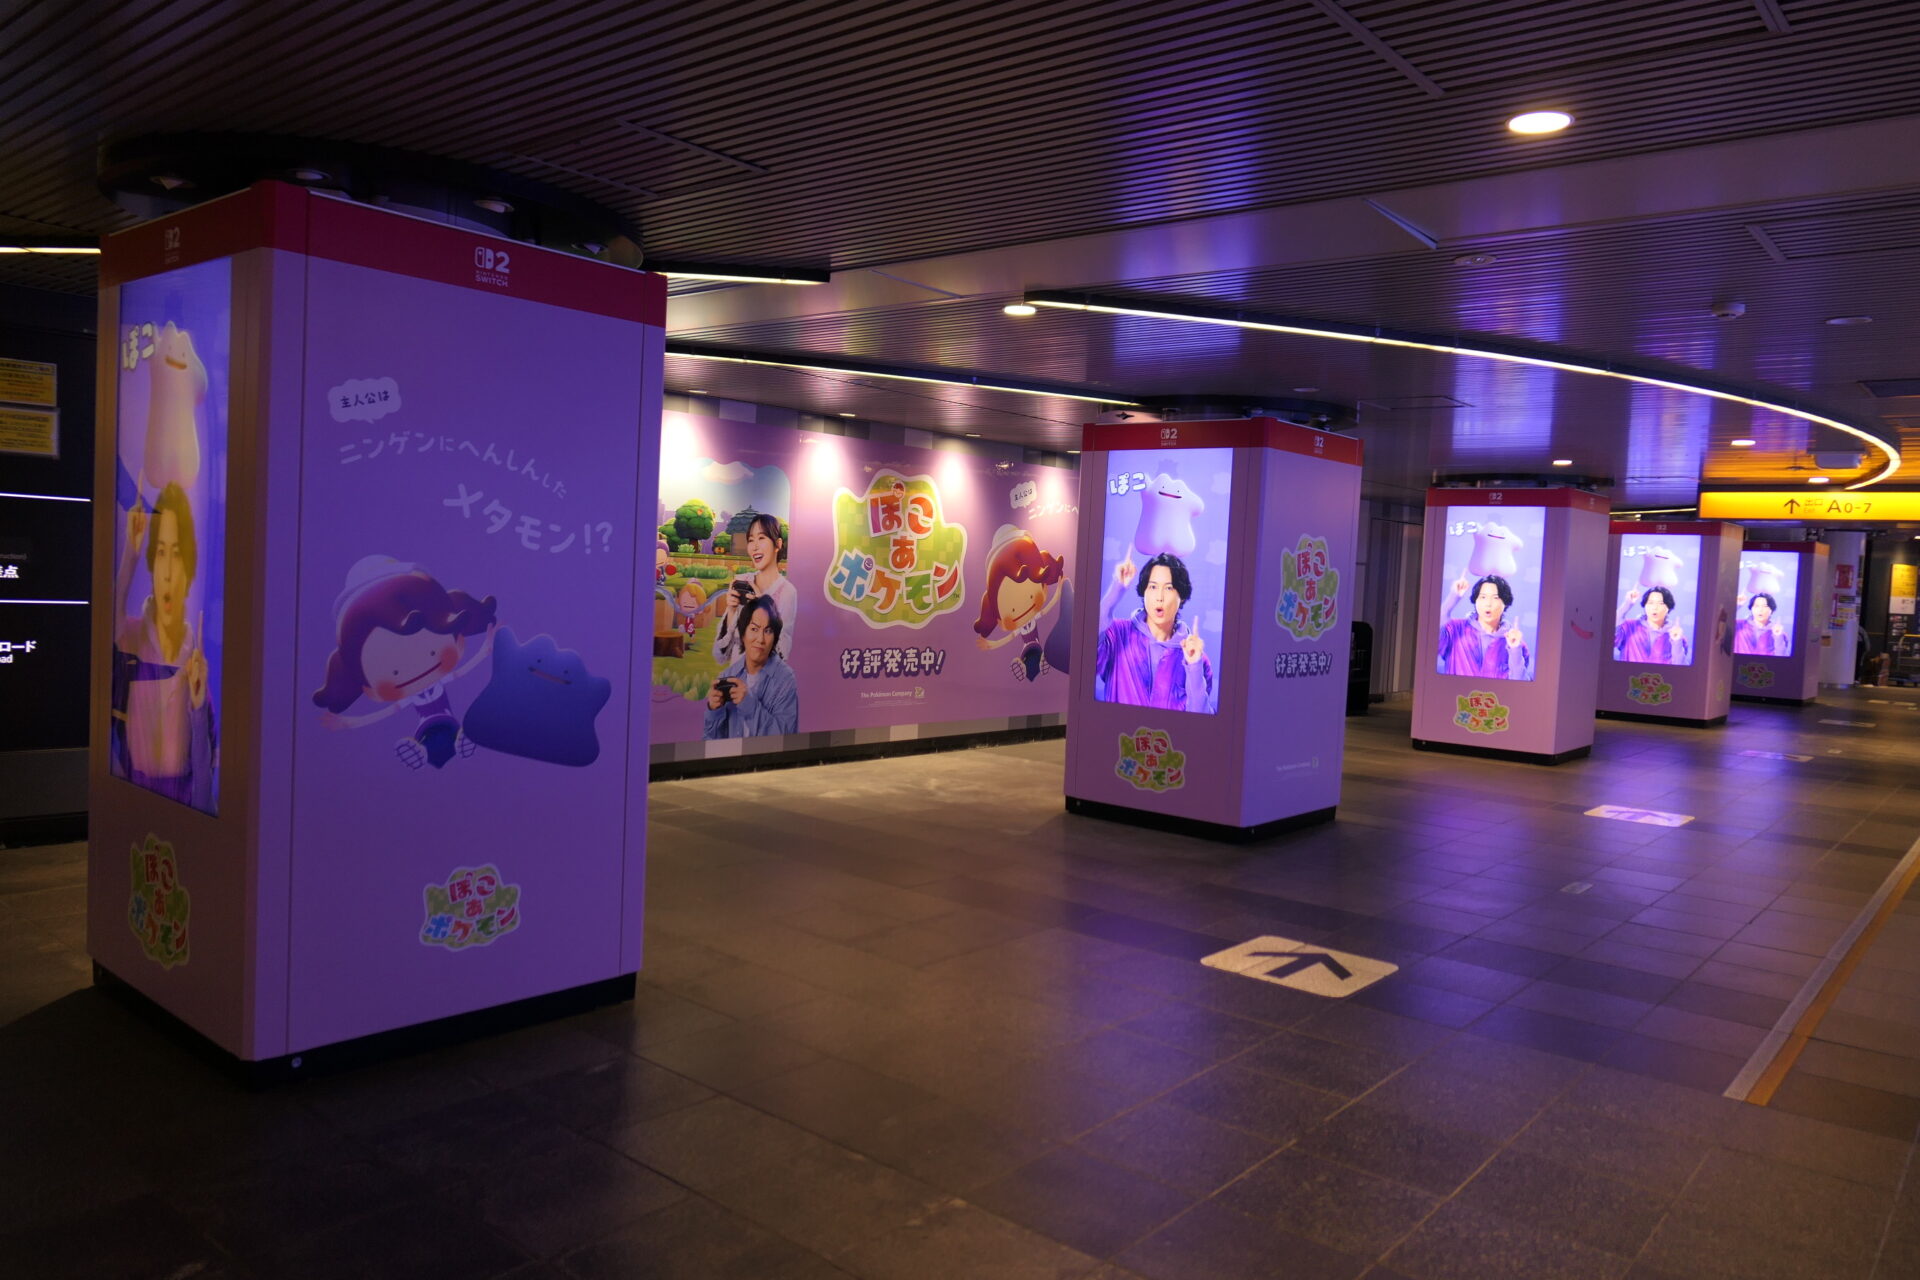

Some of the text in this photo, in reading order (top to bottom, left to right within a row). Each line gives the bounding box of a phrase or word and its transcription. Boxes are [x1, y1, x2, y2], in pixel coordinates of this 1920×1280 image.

[475, 274, 509, 287] SWITCH
[340, 390, 390, 408] 主人公は
[340, 431, 567, 499] ニンゲンにへんしんした
[1109, 472, 1146, 496] ぽこ
[442, 483, 613, 554] メタモン!?
[869, 482, 934, 535] ぽこ
[0, 565, 20, 578] 点
[1296, 542, 1326, 578] ぽこ
[832, 552, 959, 611] ポケモン
[1279, 591, 1336, 629] ポケモン
[841, 647, 945, 677] 好評発売中!
[1275, 652, 1332, 678] 好評発売中!
[1119, 759, 1182, 785] ポケモン
[448, 871, 496, 902] ぽこ
[424, 905, 516, 942] ポケモン
